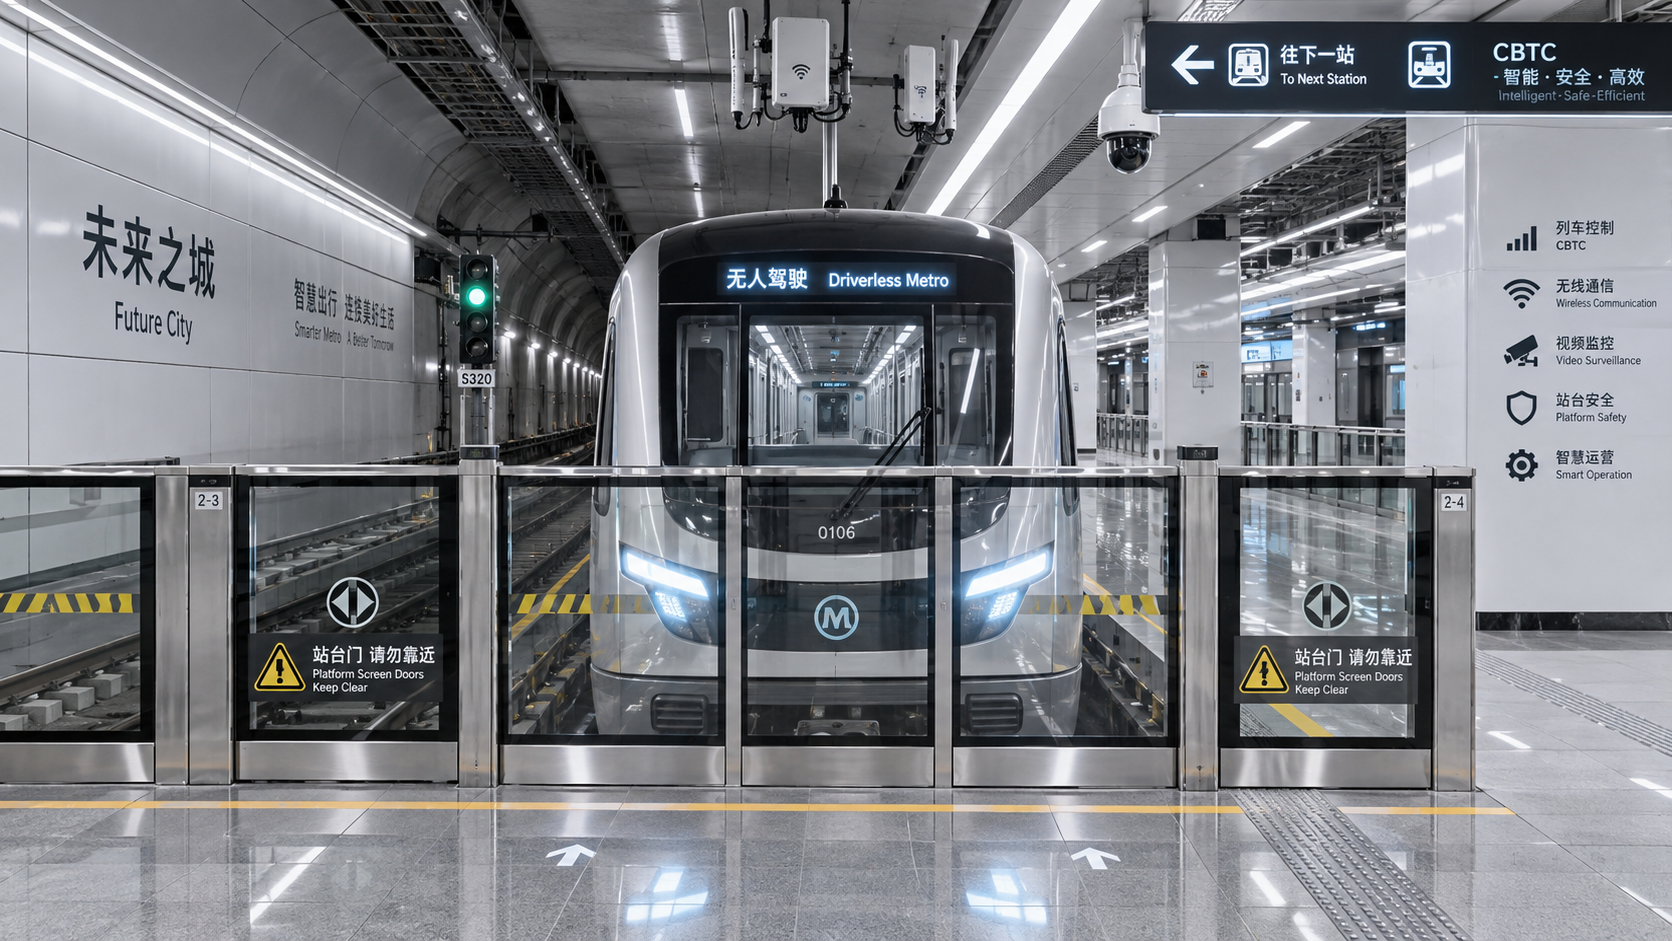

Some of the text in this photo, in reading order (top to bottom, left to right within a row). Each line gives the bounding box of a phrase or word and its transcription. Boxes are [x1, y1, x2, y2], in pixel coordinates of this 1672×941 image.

[1280, 45, 1354, 65] 往下一站
[1493, 43, 1556, 61] CBTC
[1281, 73, 1366, 84] To Next Station
[1556, 220, 1614, 235] 列车控制
[83, 204, 215, 299] 未来之城
[1556, 241, 1586, 250] CBTC
[727, 267, 949, 289] 无人驾驶 Driverless Metro
[1557, 279, 1614, 293] 无线通信
[294, 278, 337, 317] 智慧出行
[1556, 298, 1657, 307] Wireless Communication
[116, 301, 192, 345] Future City
[1556, 336, 1614, 350] 视频监控
[1556, 356, 1641, 365] Video Surveillance
[462, 373, 491, 384] S320
[1556, 393, 1614, 407] 站台安全
[1556, 412, 1626, 424] Platform Safety
[1556, 450, 1614, 465] 智慧运营
[1556, 470, 1632, 481] Smart Operation
[198, 494, 219, 506] 2-3
[1445, 496, 1464, 508] 2-4
[818, 526, 855, 540] 0106
[313, 645, 362, 663] 站台门
[1295, 648, 1341, 666] 站台门
[313, 669, 424, 679] Platform Screen Doors
[1295, 671, 1403, 681] Platform Screen Doors
[313, 682, 368, 694] Keep Clear
[1296, 685, 1348, 696] Keep Clear
